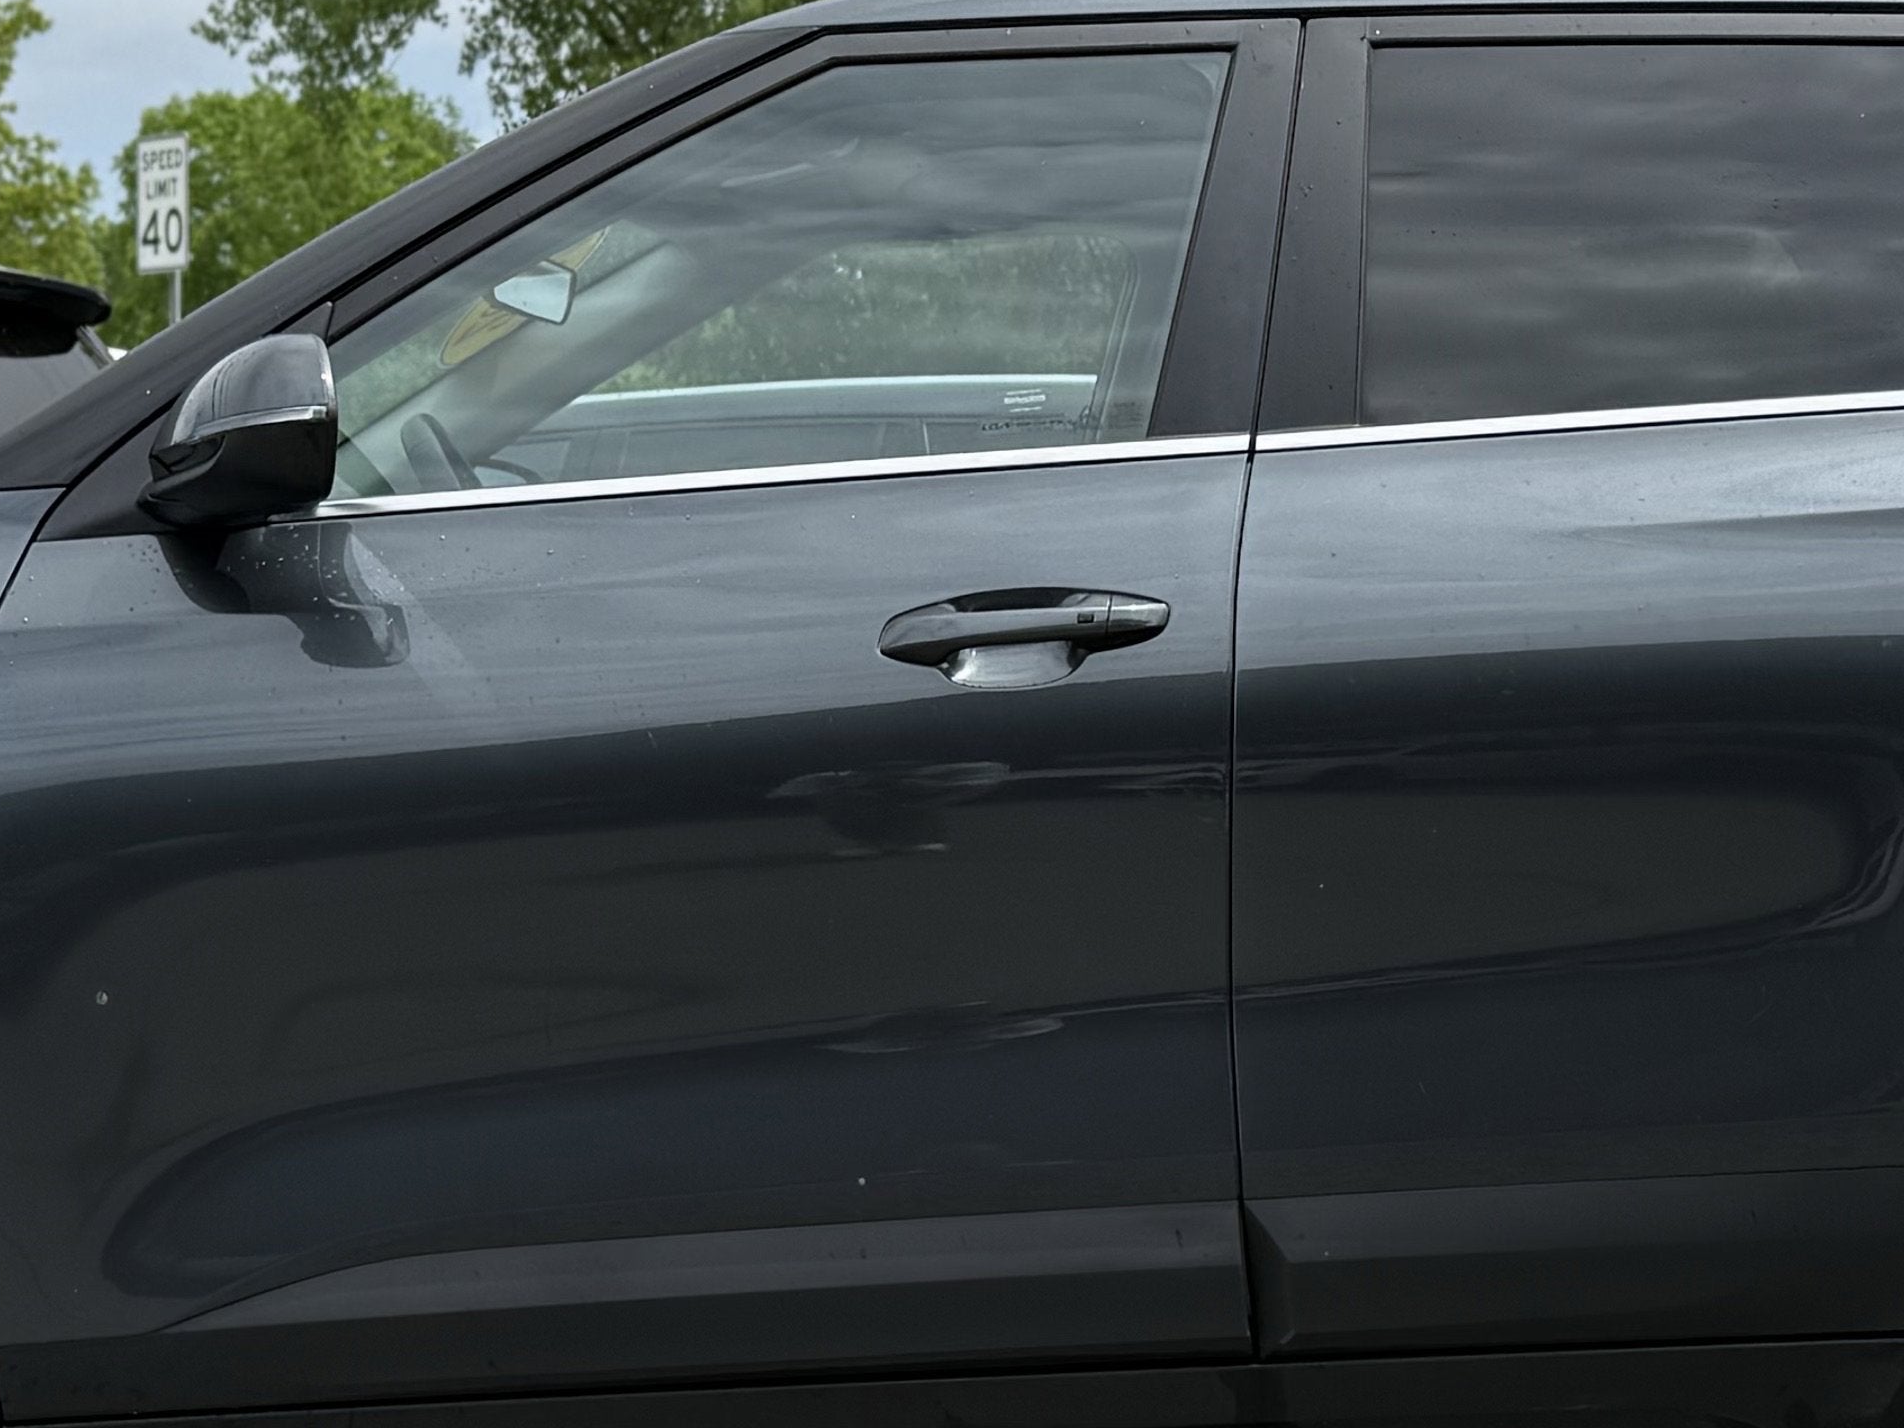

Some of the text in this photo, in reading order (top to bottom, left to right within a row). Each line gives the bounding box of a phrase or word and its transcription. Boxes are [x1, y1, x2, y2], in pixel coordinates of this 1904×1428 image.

[142, 149, 183, 172] SPEED
[146, 177, 178, 201] LIMIT
[142, 207, 183, 255] 40
